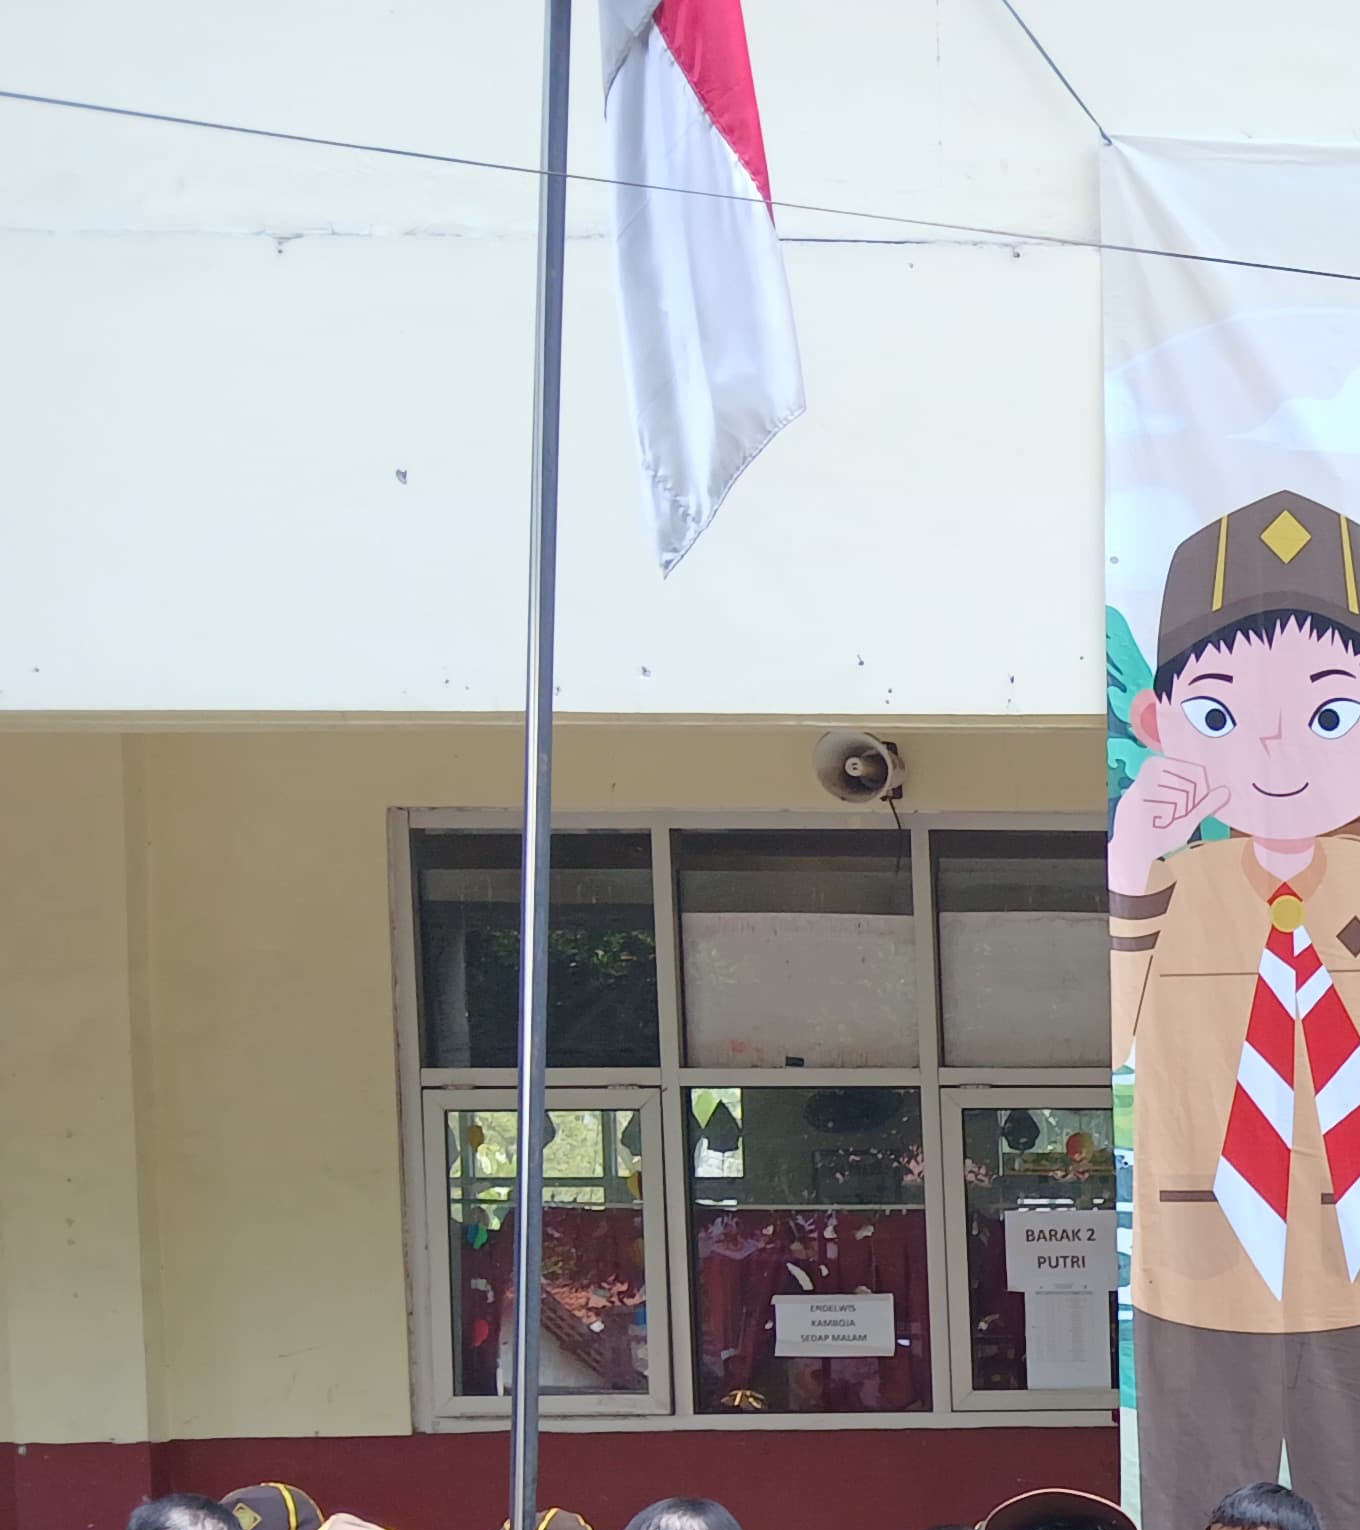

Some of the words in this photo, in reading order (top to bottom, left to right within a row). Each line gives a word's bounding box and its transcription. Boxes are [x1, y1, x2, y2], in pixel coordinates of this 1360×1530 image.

[1026, 1229, 1081, 1242] BARAK
[1087, 1228, 1096, 1241] 2
[1037, 1256, 1086, 1269] PUTRI
